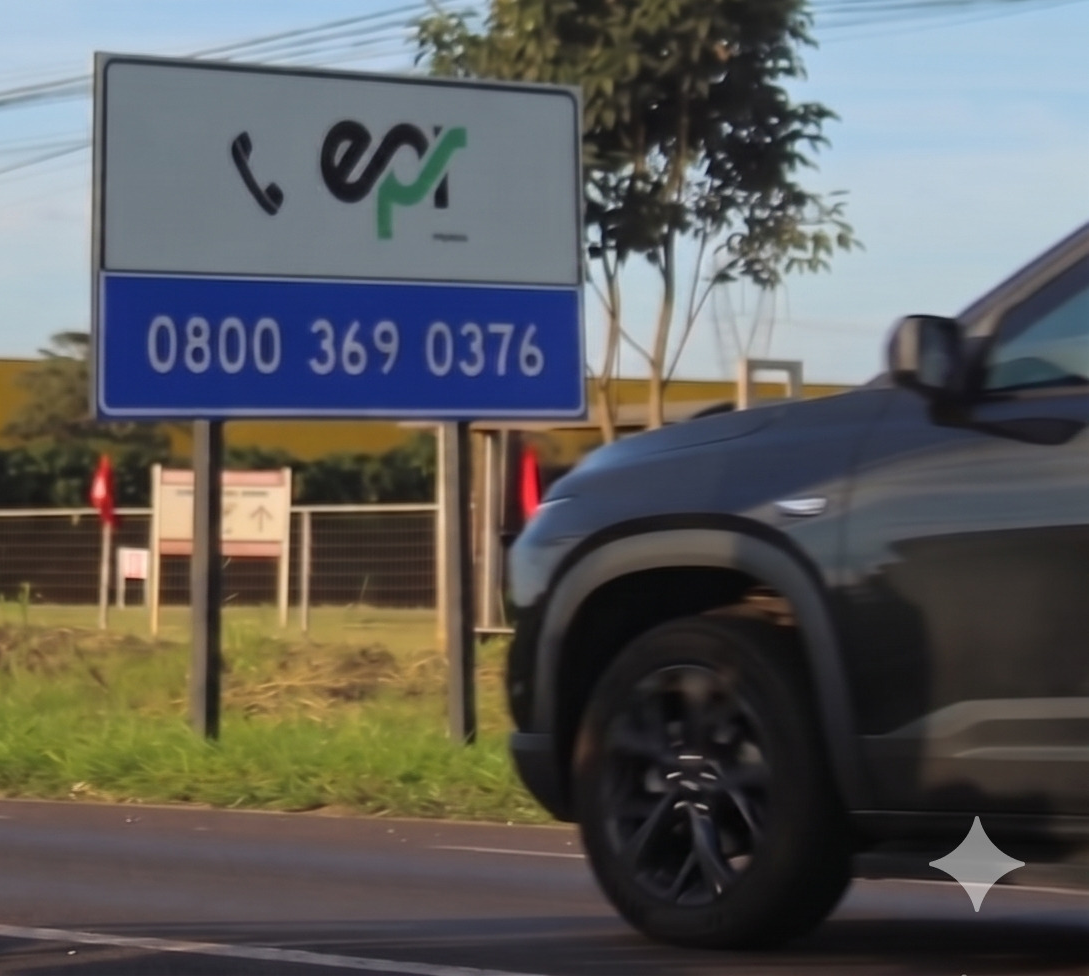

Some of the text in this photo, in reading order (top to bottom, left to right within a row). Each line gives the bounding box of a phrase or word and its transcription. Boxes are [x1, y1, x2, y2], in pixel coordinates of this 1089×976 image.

[147, 315, 544, 377] 0800 369 0376
